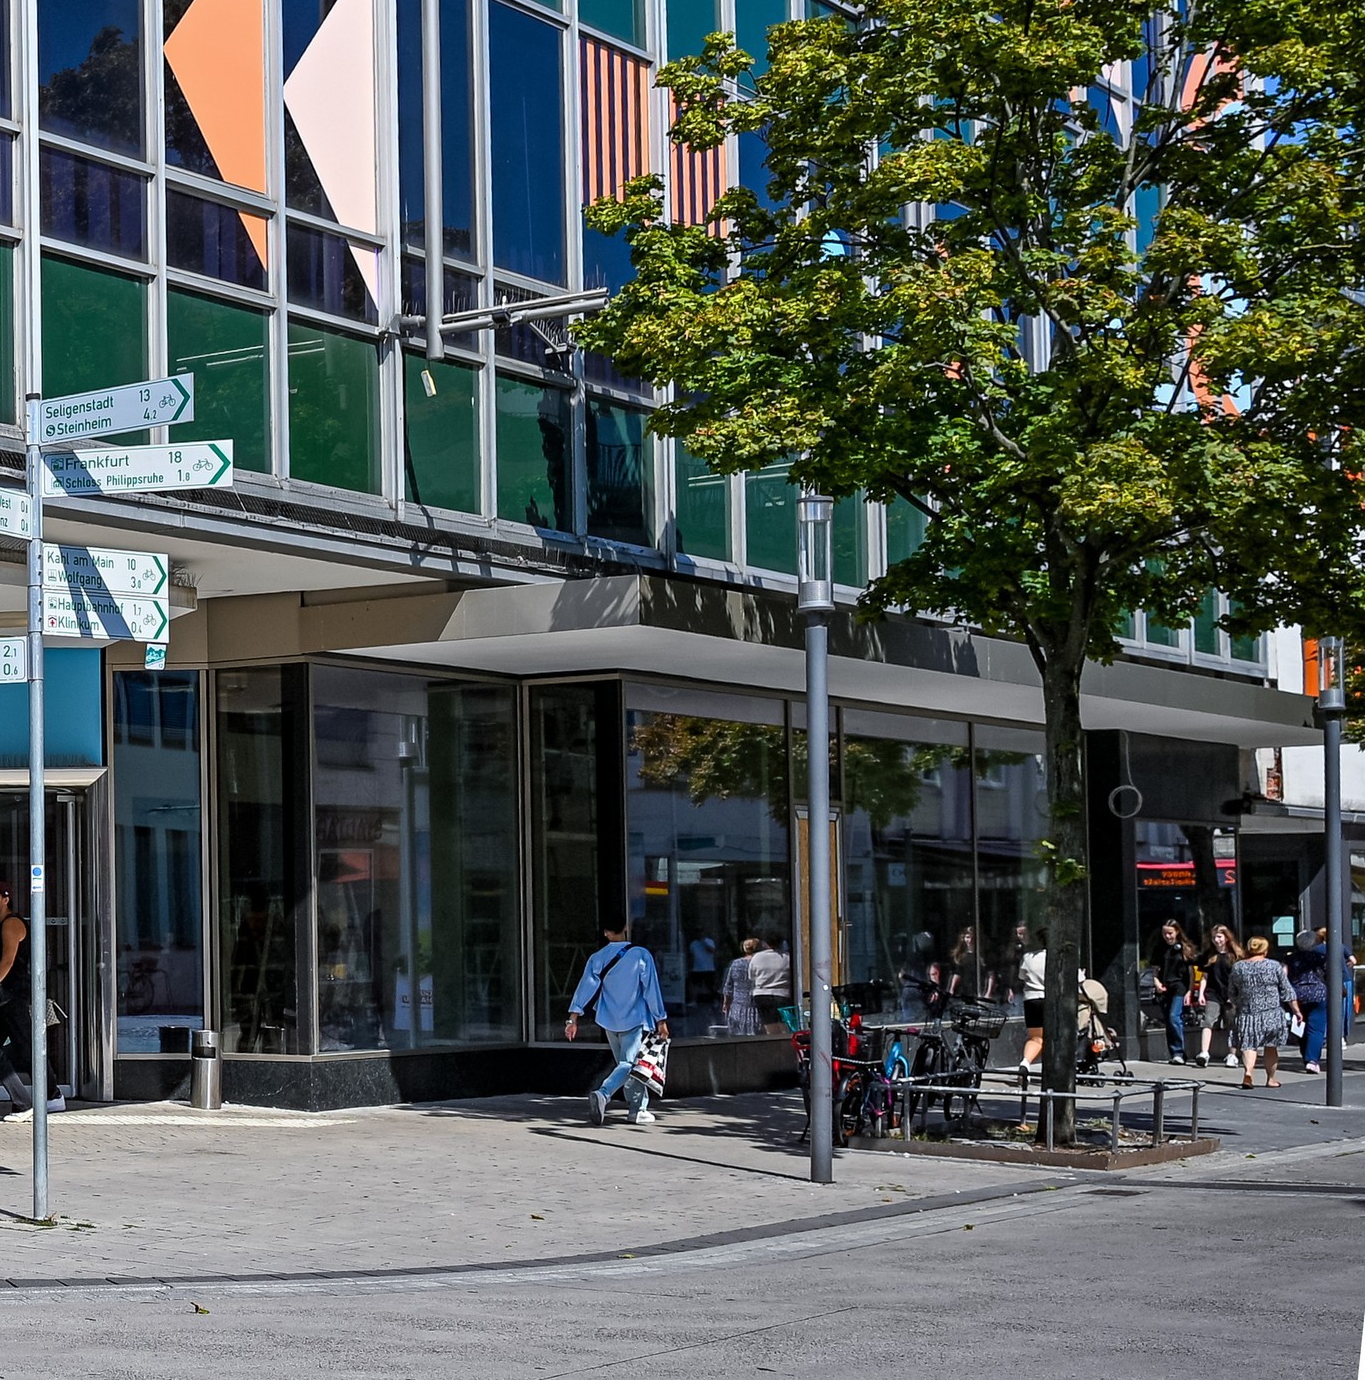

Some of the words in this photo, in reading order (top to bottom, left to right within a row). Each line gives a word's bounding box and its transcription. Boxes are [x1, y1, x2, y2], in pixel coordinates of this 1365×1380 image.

[45, 395, 114, 419] Seligenstadt
[139, 388, 151, 403] 13
[56, 417, 112, 435] Steinheim
[143, 408, 157, 421] 4.2
[65, 454, 130, 470] Frankfurt
[168, 451, 182, 463] 18
[65, 477, 102, 488] Schloss
[106, 473, 164, 488] Philippsruhe
[47, 550, 69, 565] Kahl
[73, 556, 88, 567] am
[92, 555, 115, 569] Main
[127, 558, 137, 570] 10
[58, 569, 103, 589] Wolfgang
[58, 597, 124, 614] Hauptbahnhof
[58, 616, 99, 631] Klinikum
[3, 645, 17, 658] 2.1
[3, 663, 18, 676] 0.6
